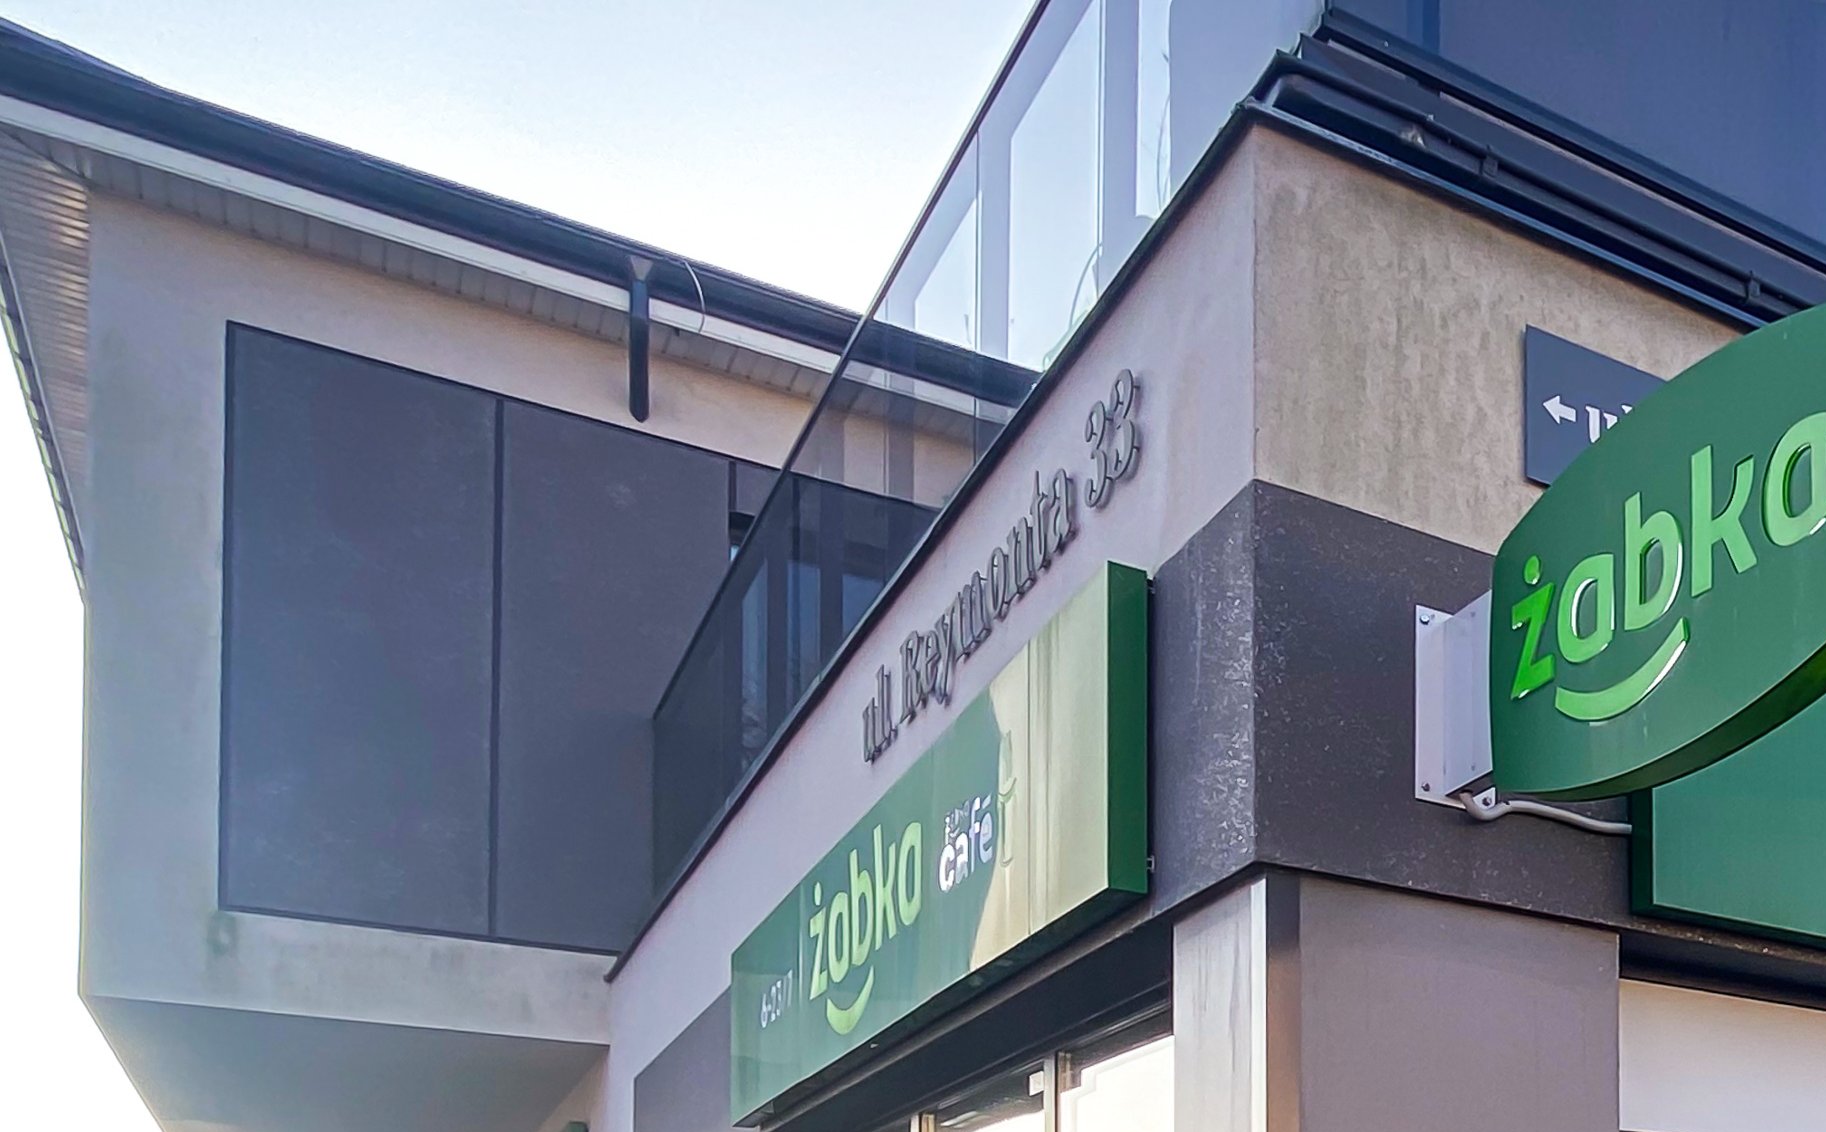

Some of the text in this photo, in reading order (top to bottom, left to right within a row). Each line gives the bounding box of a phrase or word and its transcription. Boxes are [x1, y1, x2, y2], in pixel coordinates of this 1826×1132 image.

[899, 469, 1077, 724] Reymonta
[1084, 368, 1142, 508] 33
[808, 822, 922, 1000] żabka
[938, 794, 993, 893] café
